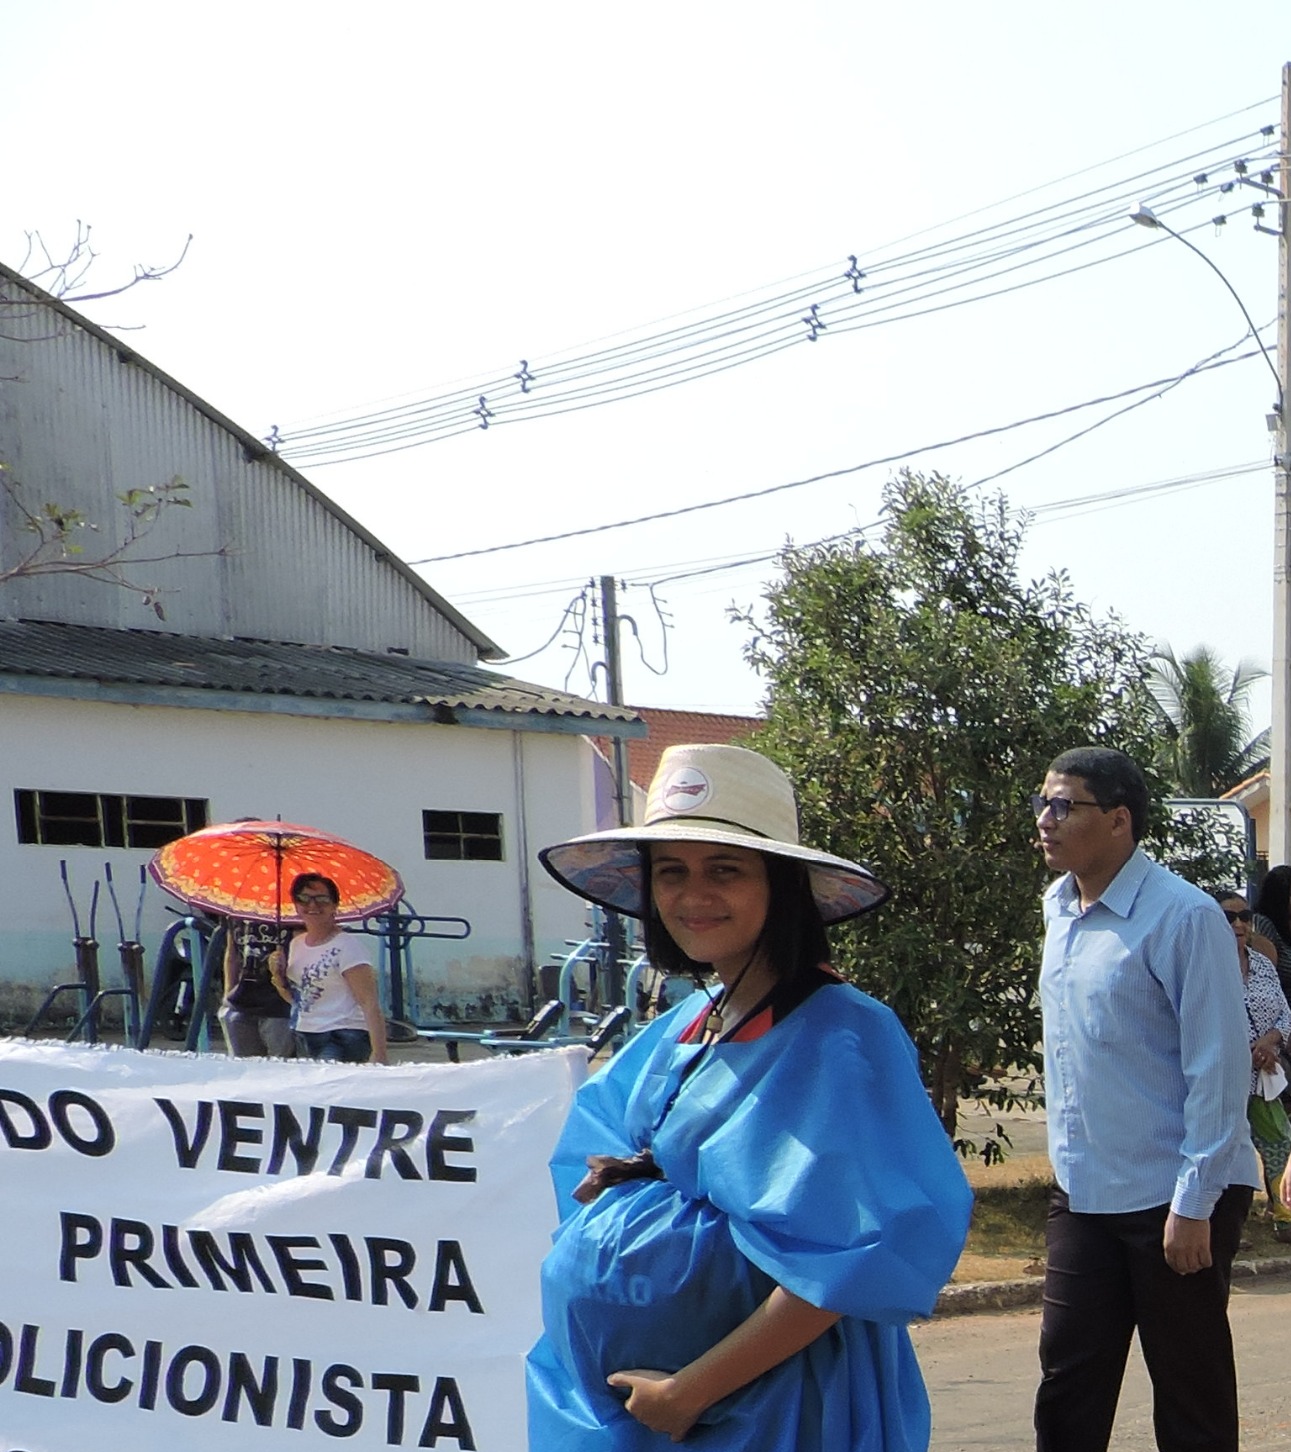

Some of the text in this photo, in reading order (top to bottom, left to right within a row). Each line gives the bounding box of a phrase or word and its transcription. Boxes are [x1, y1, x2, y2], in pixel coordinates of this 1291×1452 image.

[0, 1088, 478, 1184] DO VENTRE
[58, 1211, 486, 1315] PRIMEIRA
[0, 1320, 478, 1452] LICIONISTA
